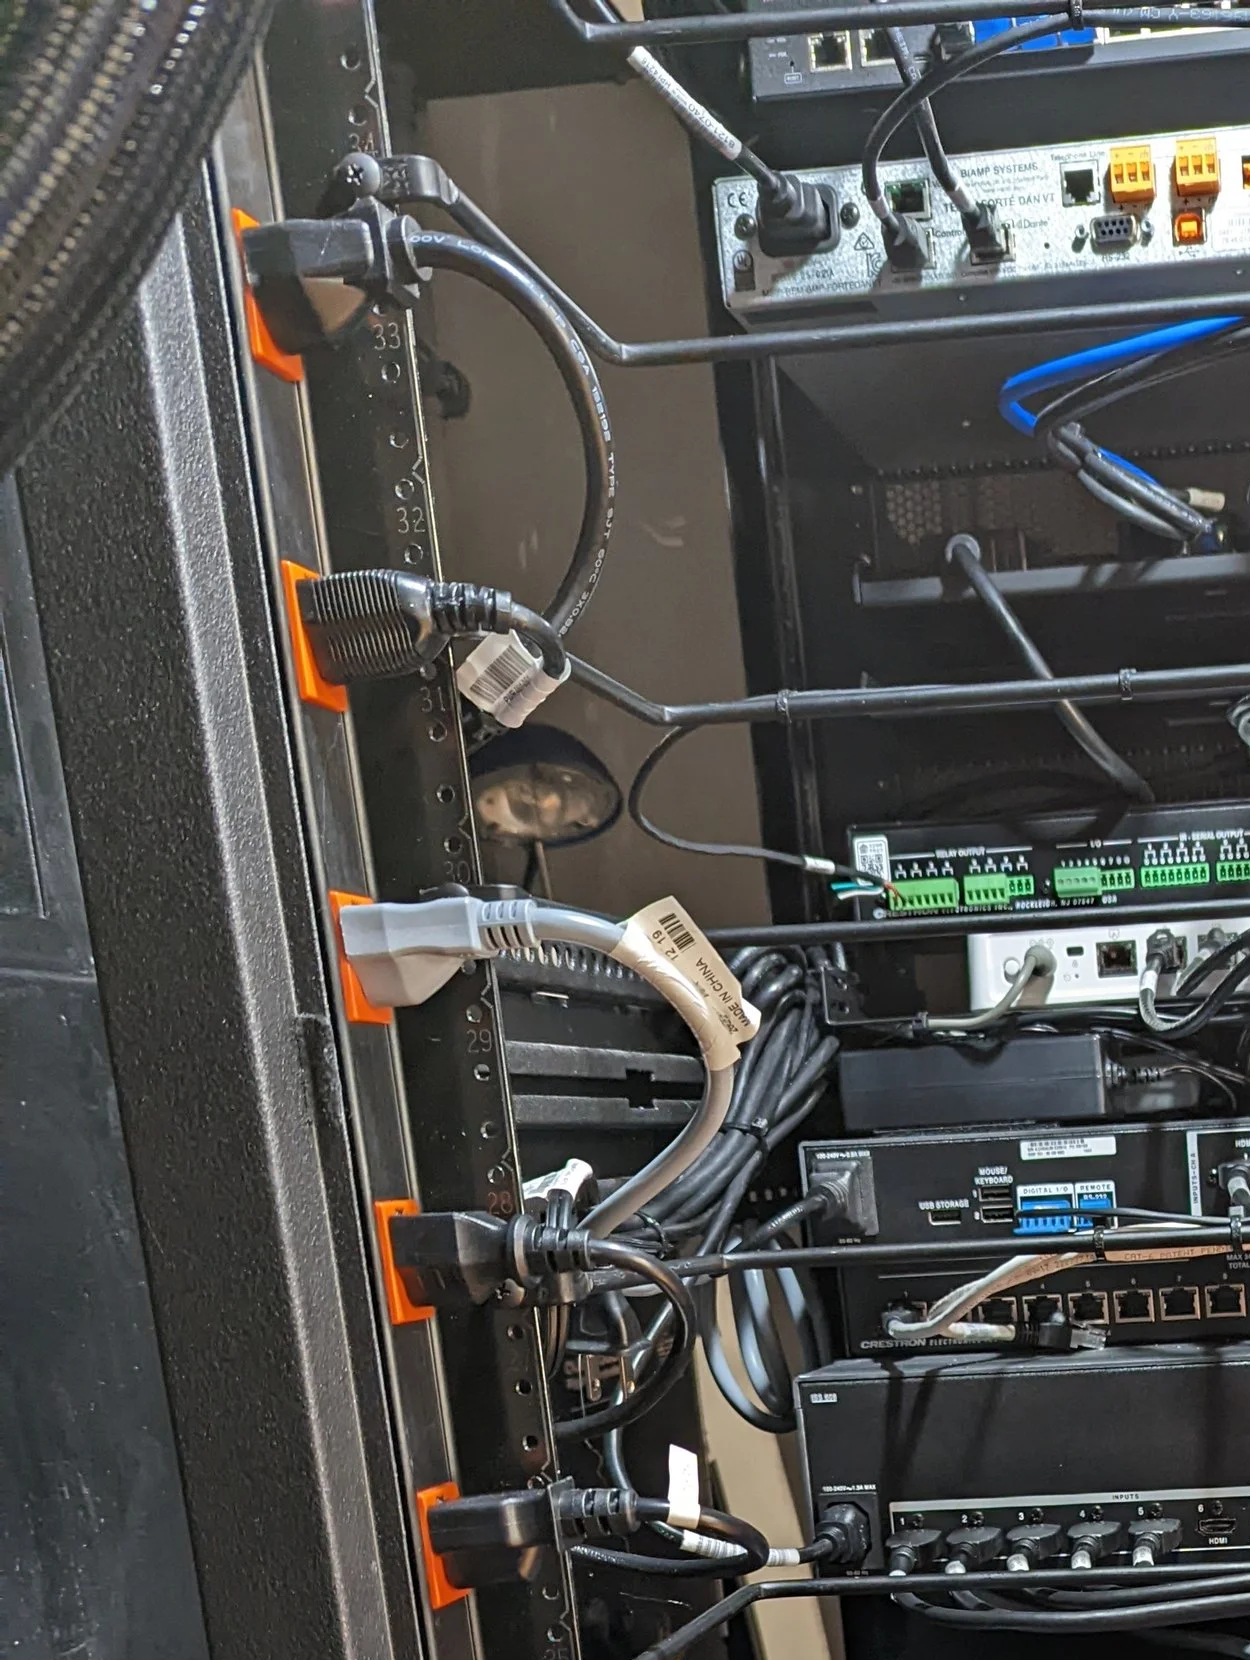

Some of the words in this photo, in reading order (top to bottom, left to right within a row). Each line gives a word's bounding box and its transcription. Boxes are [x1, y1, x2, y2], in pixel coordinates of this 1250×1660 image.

[397, 507, 426, 534] 32
[466, 1031, 493, 1053] 29
[860, 1338, 926, 1350] CRESTRON
